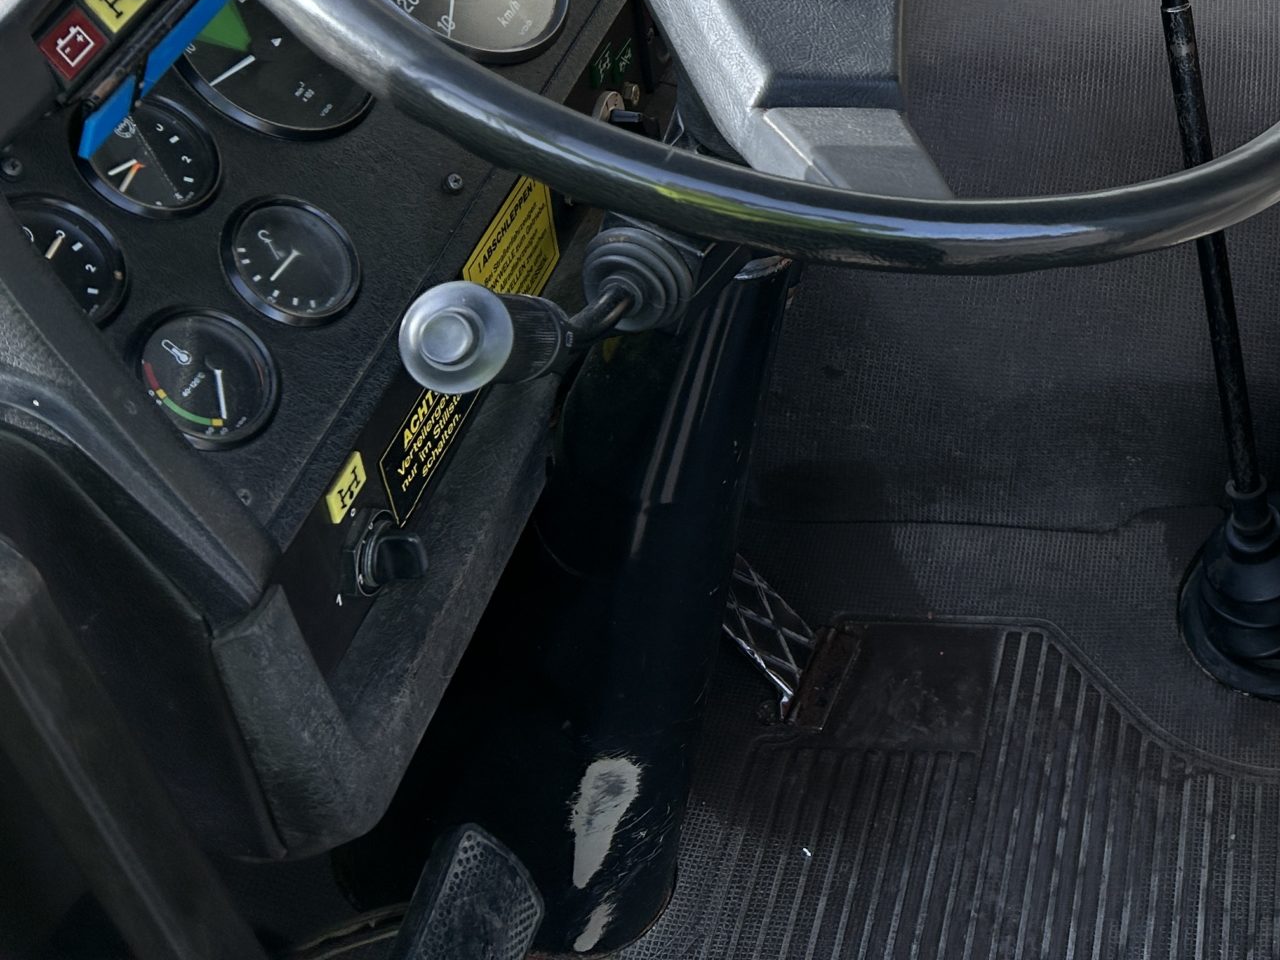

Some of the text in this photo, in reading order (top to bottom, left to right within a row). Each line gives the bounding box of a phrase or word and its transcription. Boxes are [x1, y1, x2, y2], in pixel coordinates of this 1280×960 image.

[437, 15, 456, 33] 10
[496, 0, 521, 28] km/h
[181, 155, 192, 164] 2
[482, 183, 534, 269] ABSCHLEPPEN
[85, 263, 97, 273] 2
[490, 248, 516, 290] NKWELLE
[403, 389, 439, 449] ACHT
[422, 413, 462, 478] schalten.
[401, 462, 418, 493] nur
[418, 441, 432, 462] im
